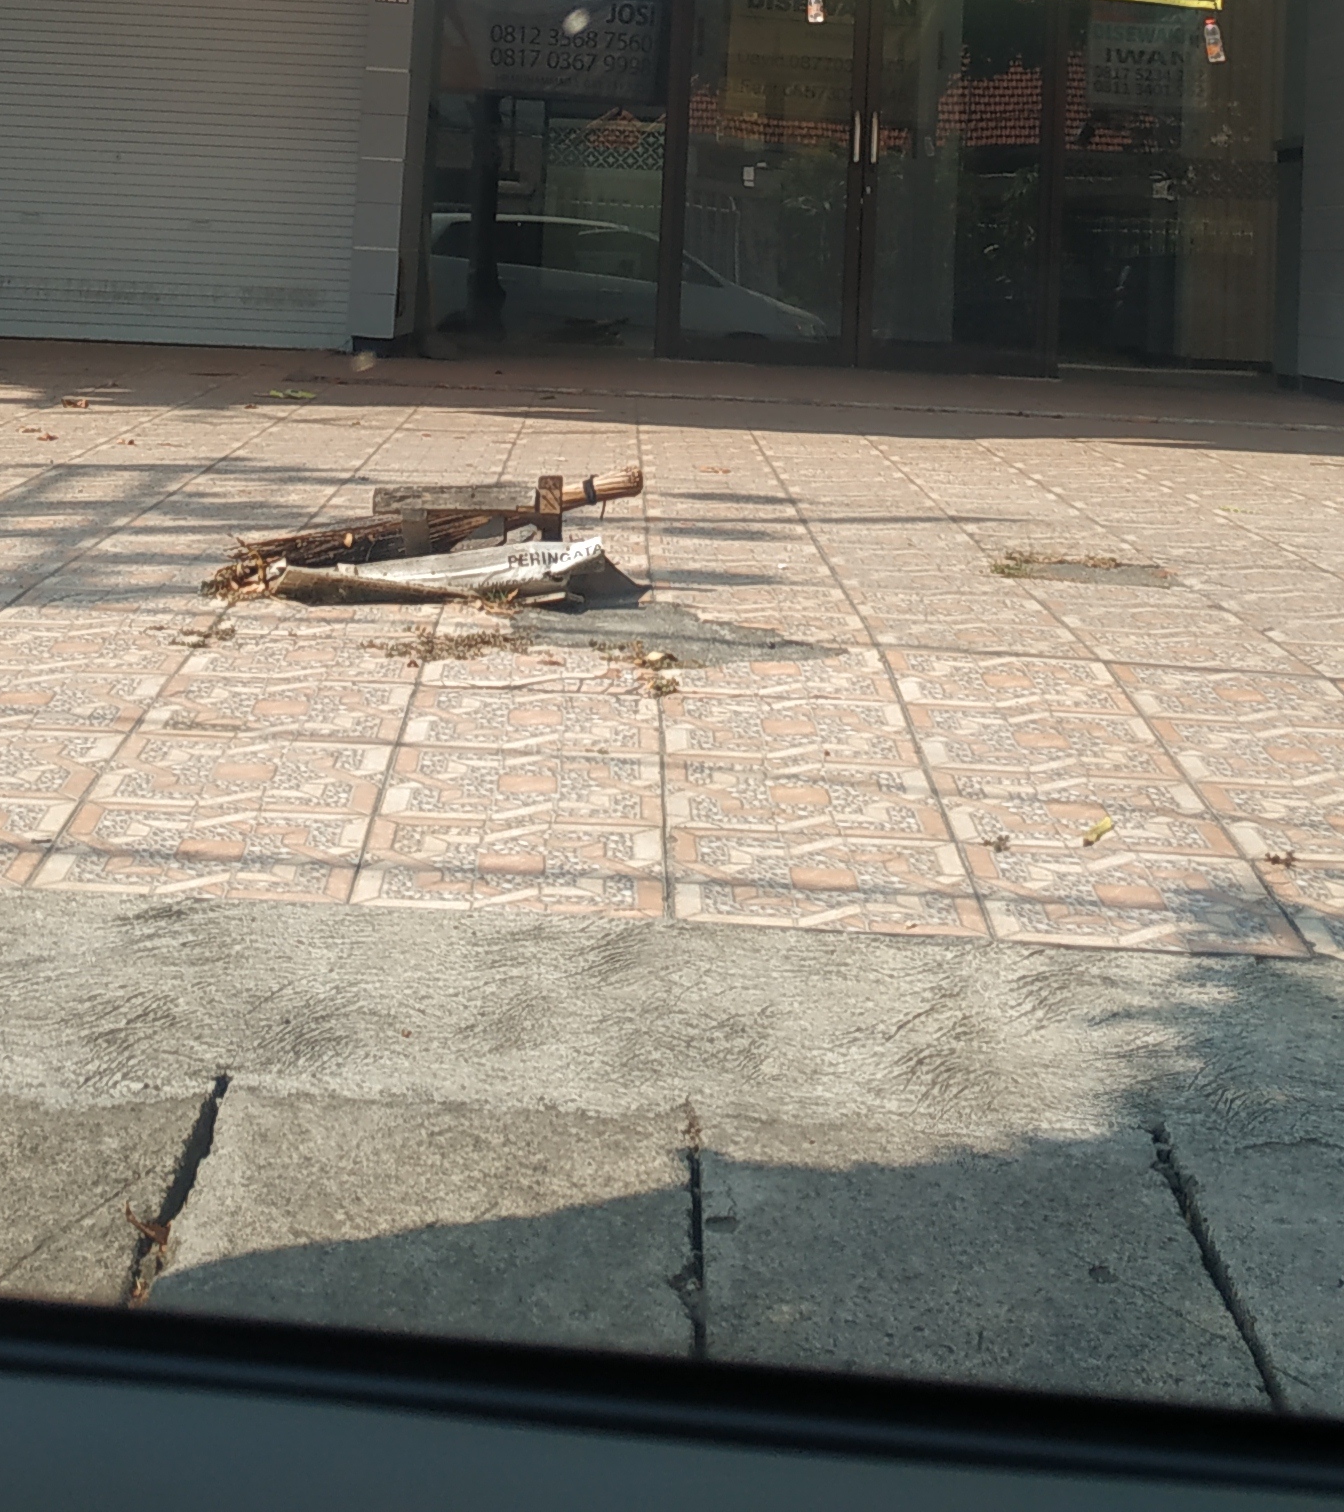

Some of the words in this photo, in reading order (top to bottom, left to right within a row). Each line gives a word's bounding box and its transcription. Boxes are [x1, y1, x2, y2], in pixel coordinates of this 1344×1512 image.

[605, 2, 655, 27] JOSI
[490, 24, 541, 46] 0812
[604, 31, 652, 54] 7560
[490, 46, 541, 68] 0817
[546, 50, 598, 72] 0367
